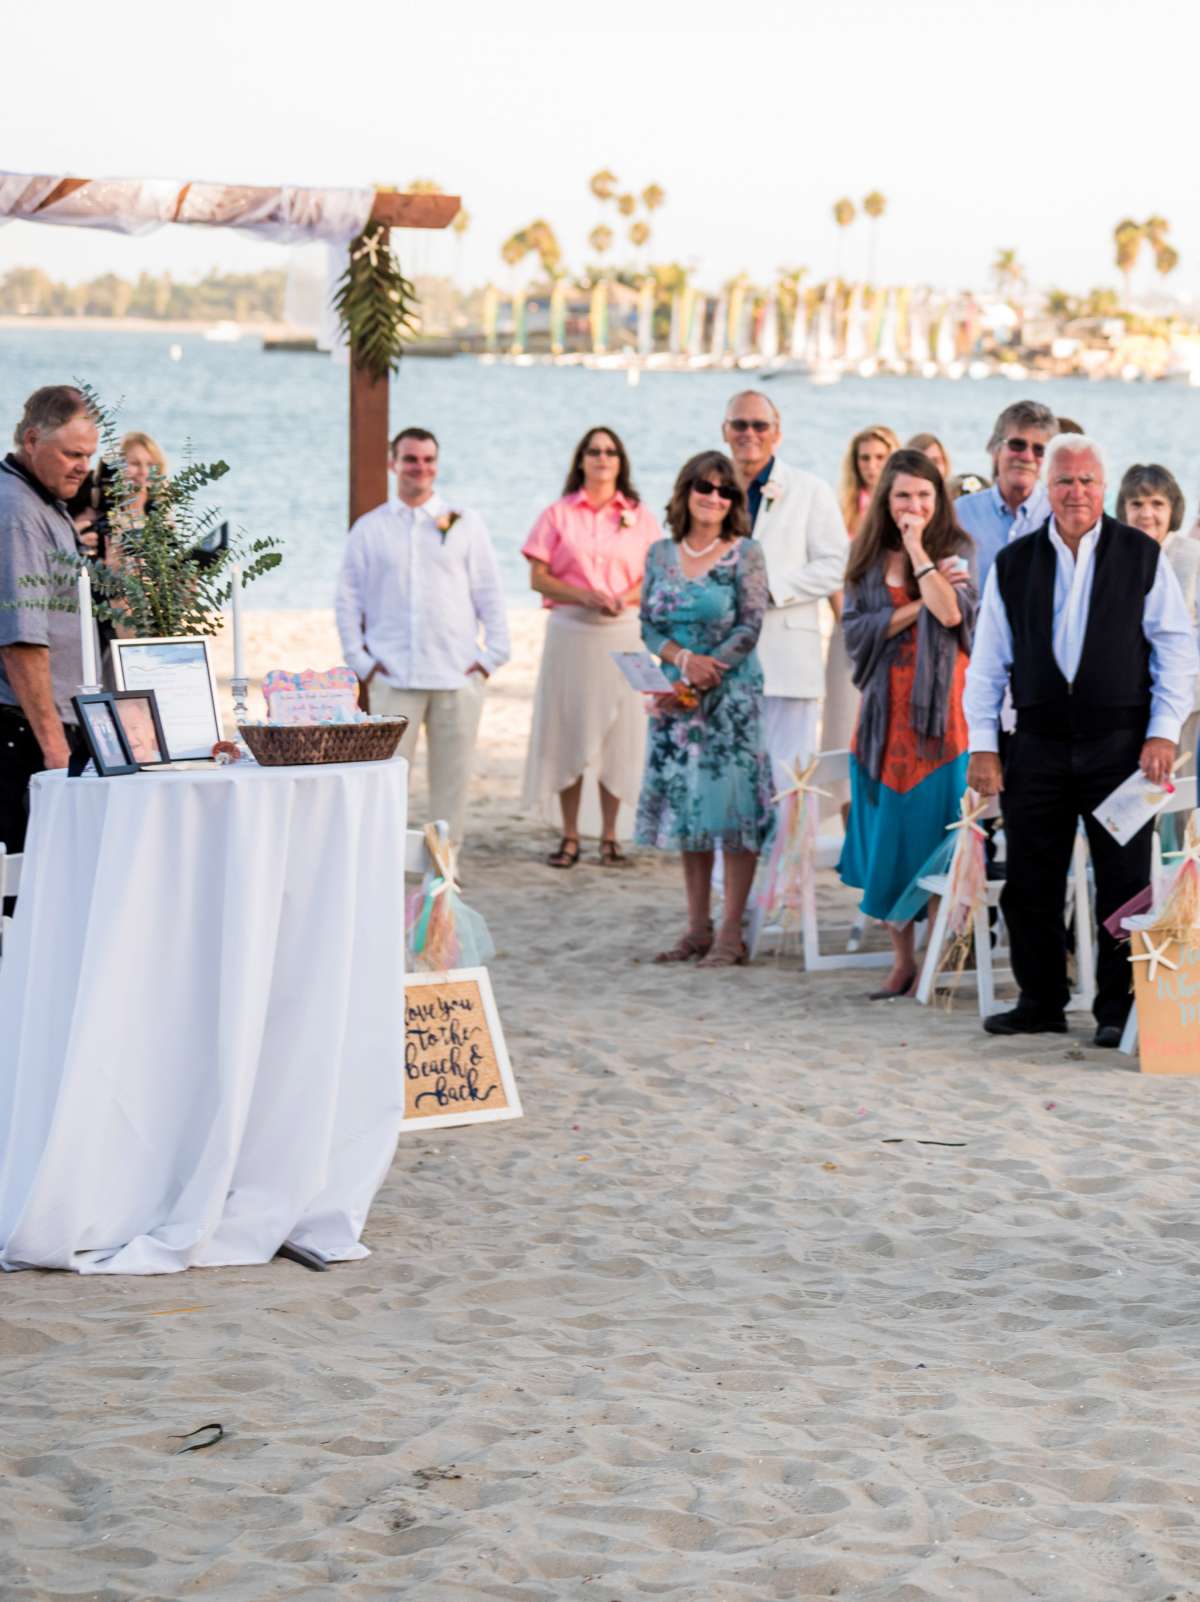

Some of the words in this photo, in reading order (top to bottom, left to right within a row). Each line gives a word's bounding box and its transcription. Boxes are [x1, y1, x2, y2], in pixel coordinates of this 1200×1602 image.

[436, 996, 474, 1022] you
[438, 1018, 482, 1047] the
[405, 1042, 466, 1080] beach
[470, 1043, 484, 1066] &
[415, 1067, 497, 1109] back
